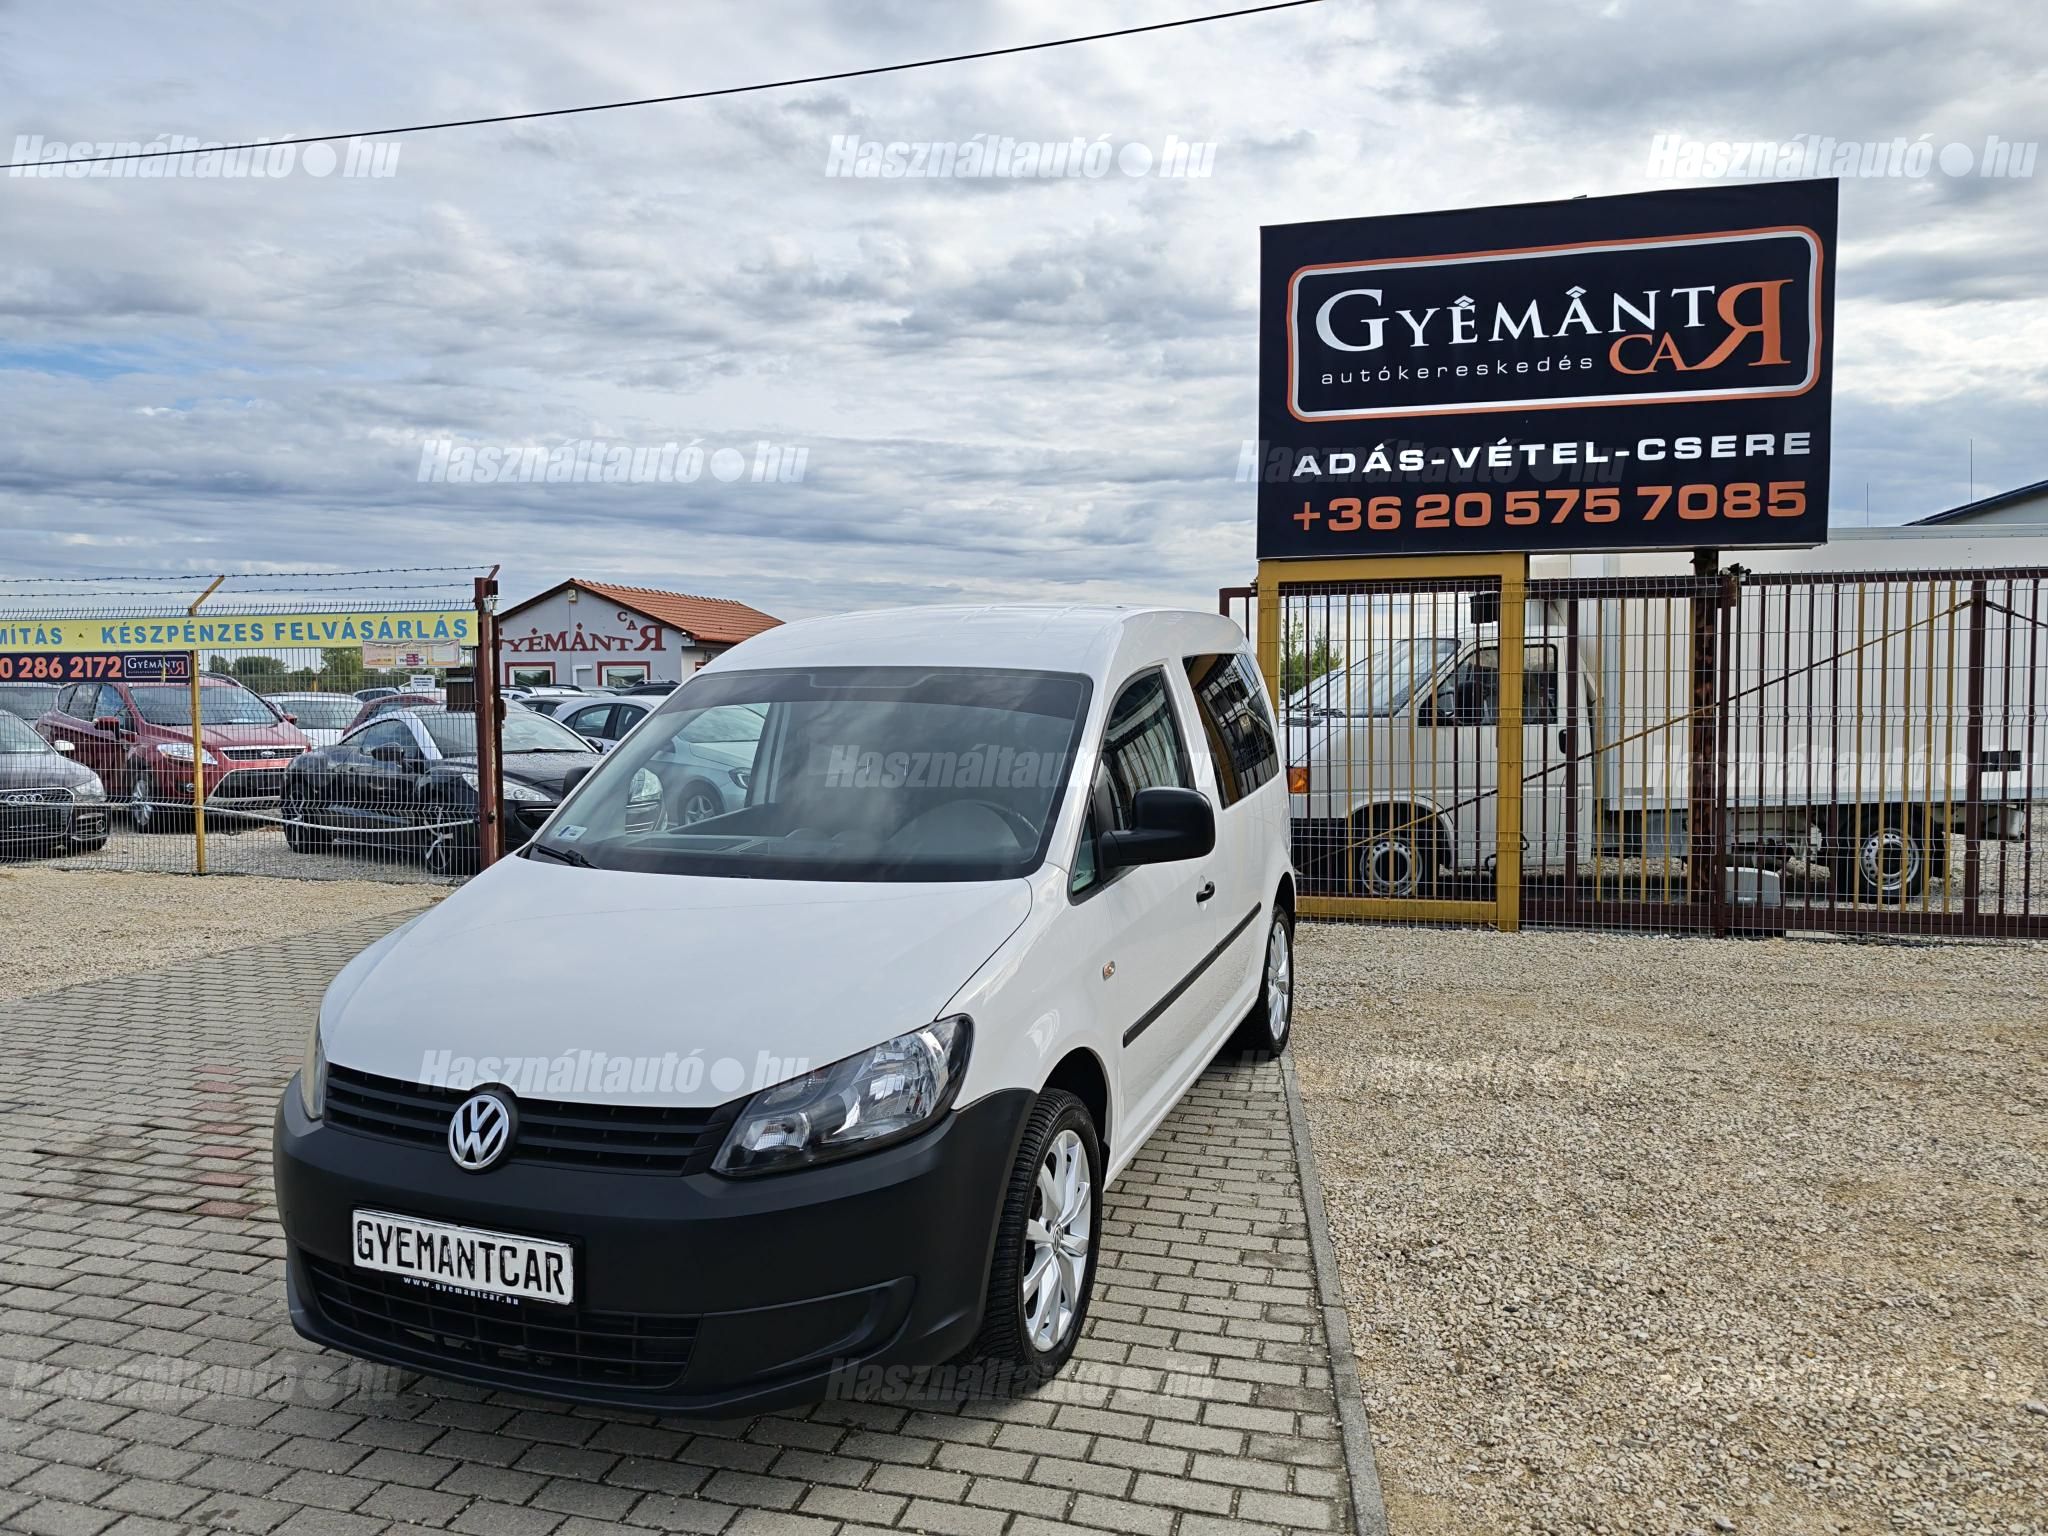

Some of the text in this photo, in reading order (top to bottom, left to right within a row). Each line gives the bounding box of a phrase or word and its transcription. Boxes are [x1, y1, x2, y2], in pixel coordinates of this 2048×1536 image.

[1320, 354, 1593, 385] autókereskedés
[1293, 480, 1807, 532] +36 20 575 7085
[101, 620, 264, 644] KÉSZPÉNZES
[274, 614, 468, 641] FELVÁSÁRLÁS
[18, 655, 64, 679] 286
[70, 655, 122, 678] 2172
[356, 1219, 566, 1296] GYEMANTCAR
